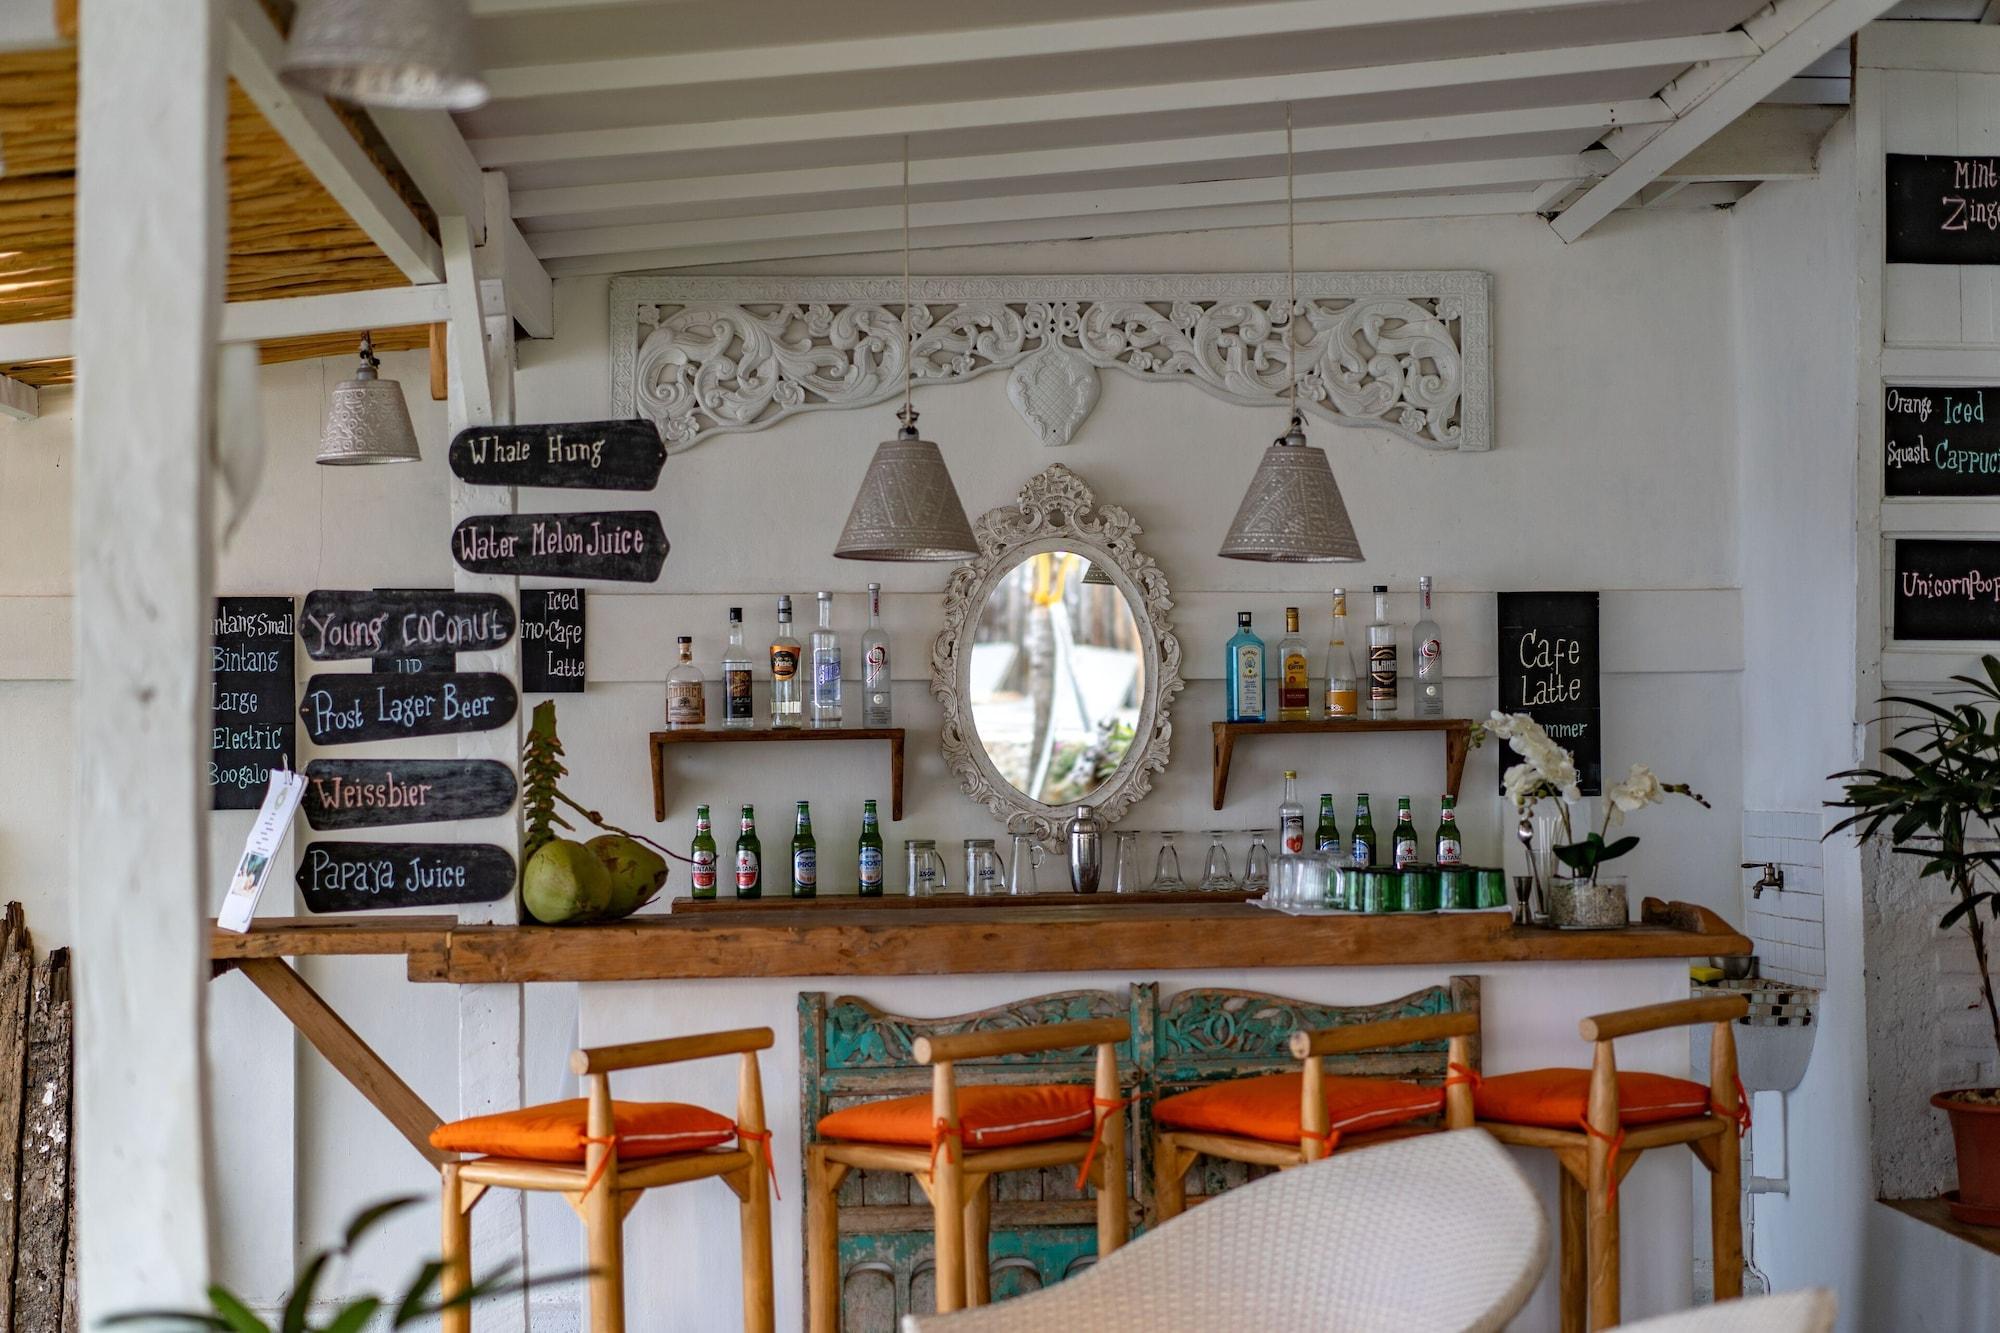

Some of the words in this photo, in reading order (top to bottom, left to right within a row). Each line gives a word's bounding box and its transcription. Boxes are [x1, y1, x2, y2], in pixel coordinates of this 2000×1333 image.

[1953, 159, 1998, 189] Mint
[1887, 389, 1932, 423] Orange
[1944, 390, 1984, 424] Iced
[468, 435, 531, 465] Whale
[547, 434, 606, 469] Hung
[1887, 434, 1931, 469] Squash
[458, 525, 519, 561] Water
[531, 522, 583, 556] Melon
[586, 521, 644, 556] Juice
[547, 588, 579, 611] Iced
[257, 612, 294, 636] Small
[308, 612, 389, 653] Young
[548, 619, 582, 650] Cafe
[211, 643, 279, 672] Bintang
[547, 650, 585, 677] Latte
[1520, 628, 1580, 675] Cafe
[211, 682, 258, 714] Large
[1521, 673, 1581, 706] Latte
[311, 690, 364, 736] Prost
[377, 686, 436, 727] Lager
[443, 683, 495, 721] Beer
[212, 725, 283, 750] Electric
[1545, 722, 1588, 738] mmer
[208, 761, 269, 789] Boogalo
[313, 772, 432, 809] Weissbier
[310, 850, 395, 894] Papaya
[406, 857, 465, 892] Juice
